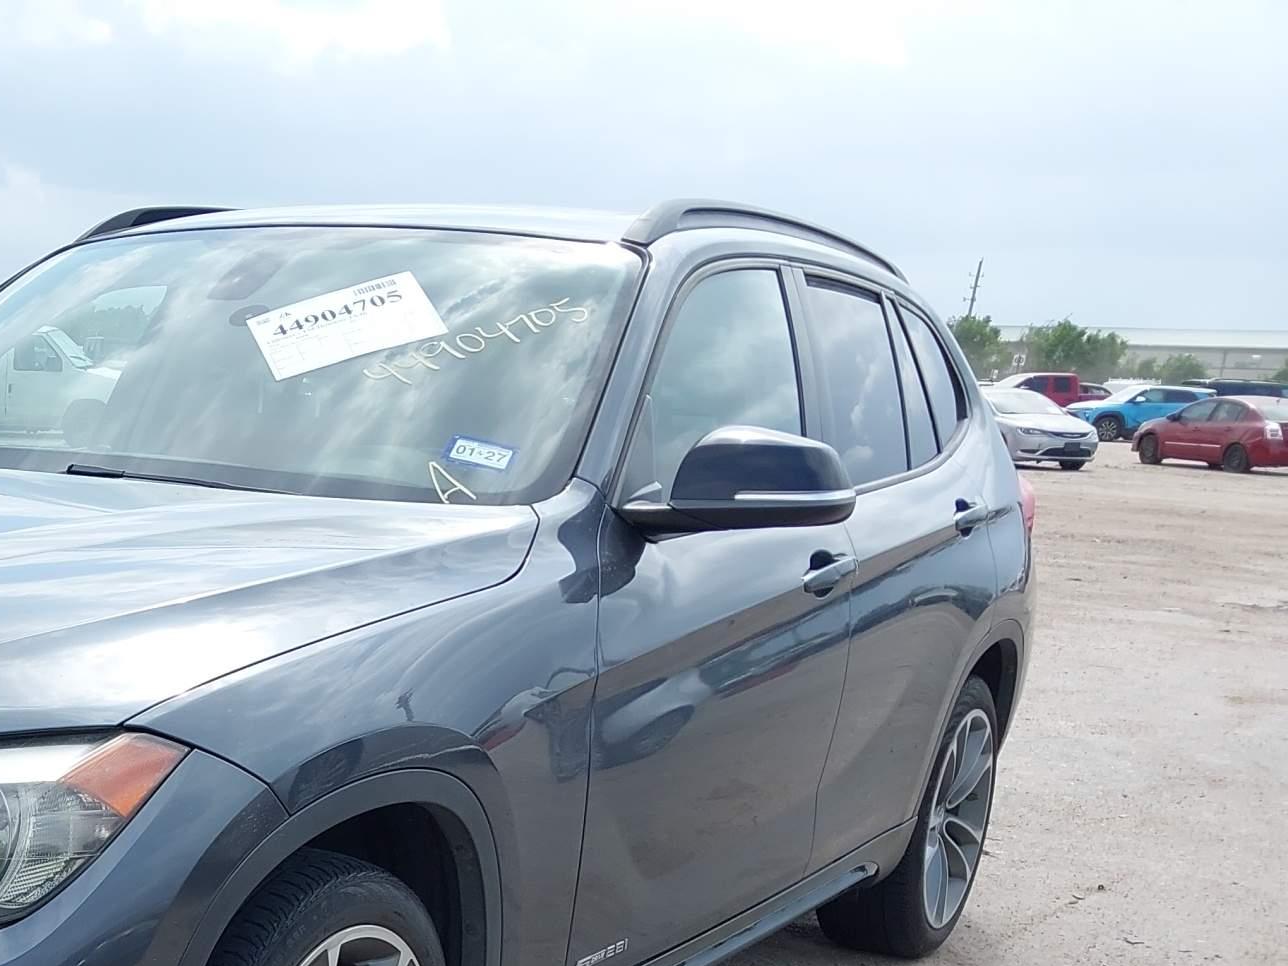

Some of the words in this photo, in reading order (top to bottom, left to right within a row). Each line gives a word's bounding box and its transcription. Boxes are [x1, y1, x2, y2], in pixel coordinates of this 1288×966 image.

[273, 289, 403, 336] 44904705
[363, 297, 588, 385] 44904705
[428, 460, 477, 504] A
